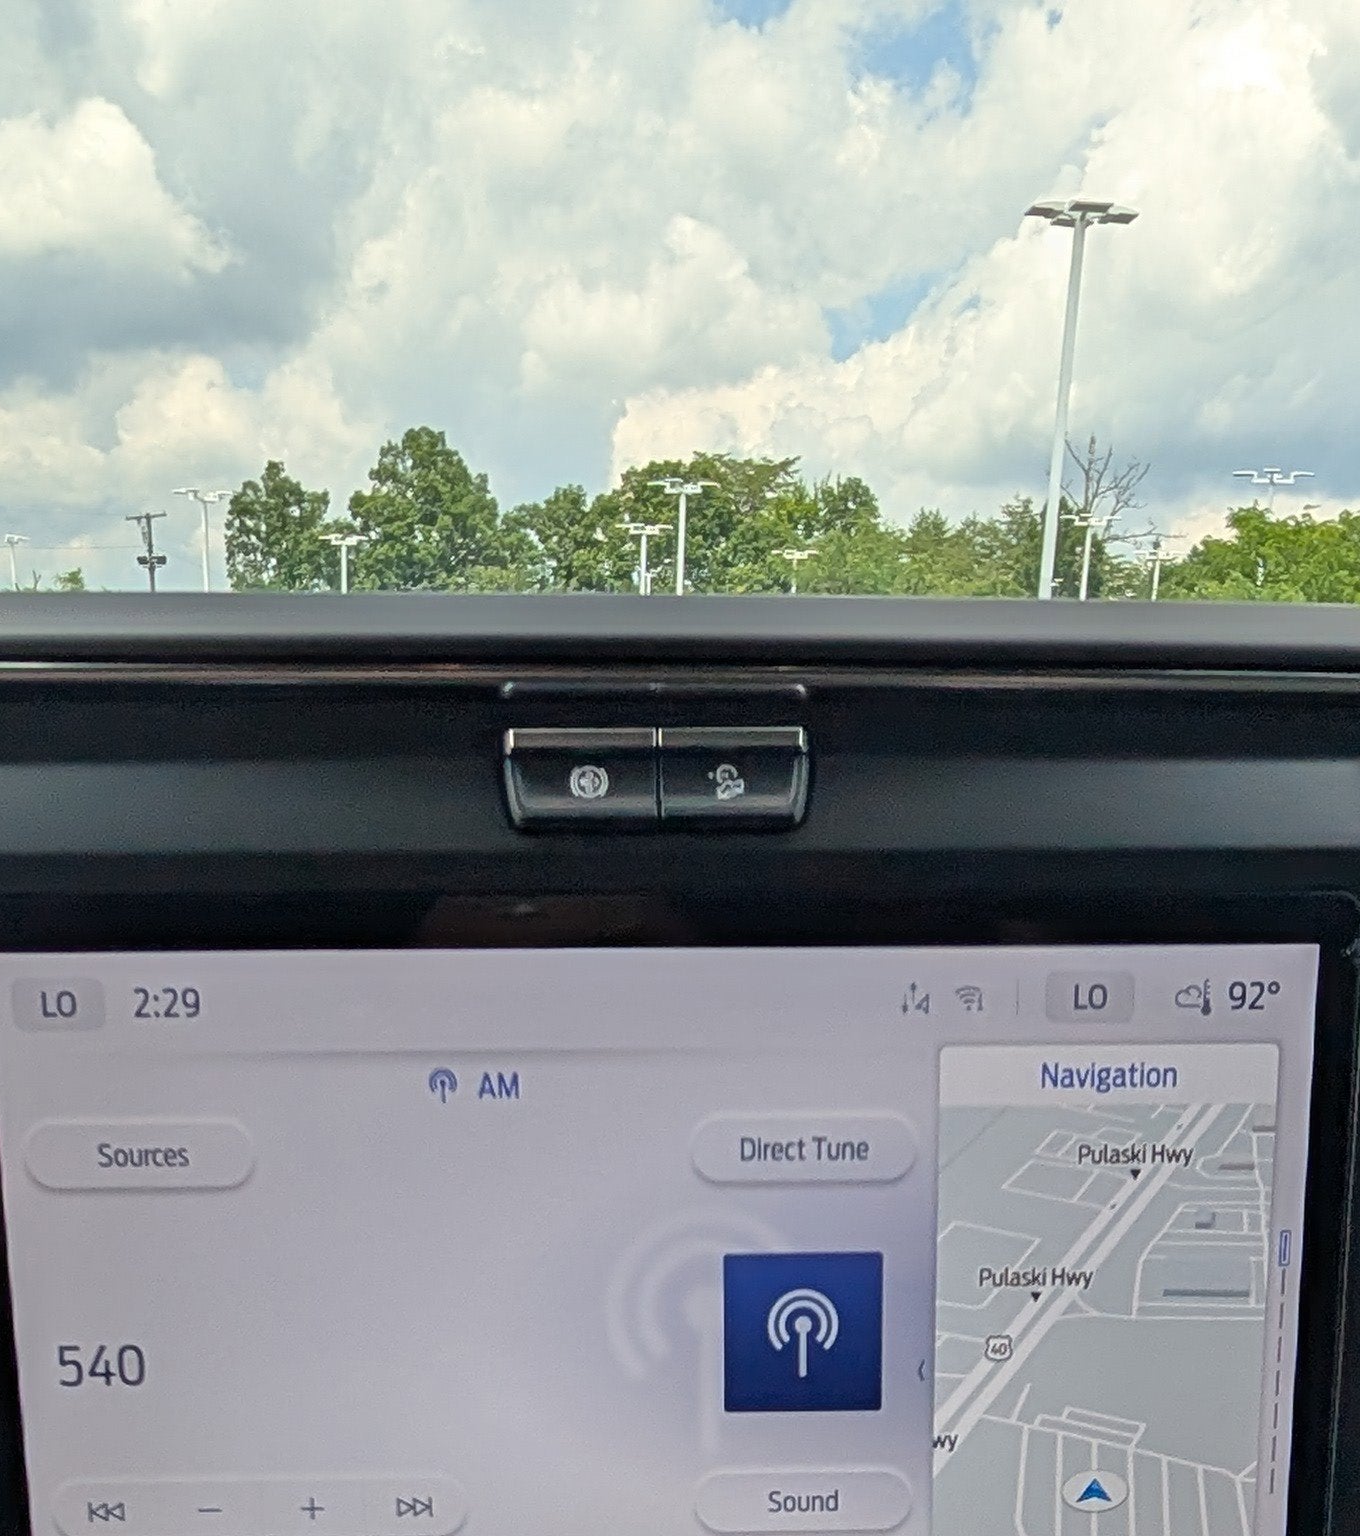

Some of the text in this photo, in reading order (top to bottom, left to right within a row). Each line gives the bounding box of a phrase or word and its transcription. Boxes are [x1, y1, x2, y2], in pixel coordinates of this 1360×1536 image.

[40, 989, 78, 1019] LO
[132, 986, 202, 1020] 2:29
[1072, 982, 1109, 1012] LO
[1228, 978, 1282, 1013] 92°
[477, 1071, 521, 1101] AM
[1041, 1060, 1179, 1094] Navigation
[97, 1140, 191, 1170] Sources
[739, 1135, 870, 1163] Direct Tune
[1077, 1142, 1195, 1170] Pulaski Hwy
[978, 1266, 1094, 1291] Pulaski Hwy
[56, 1343, 147, 1388] 540
[767, 1489, 839, 1514] Sound
